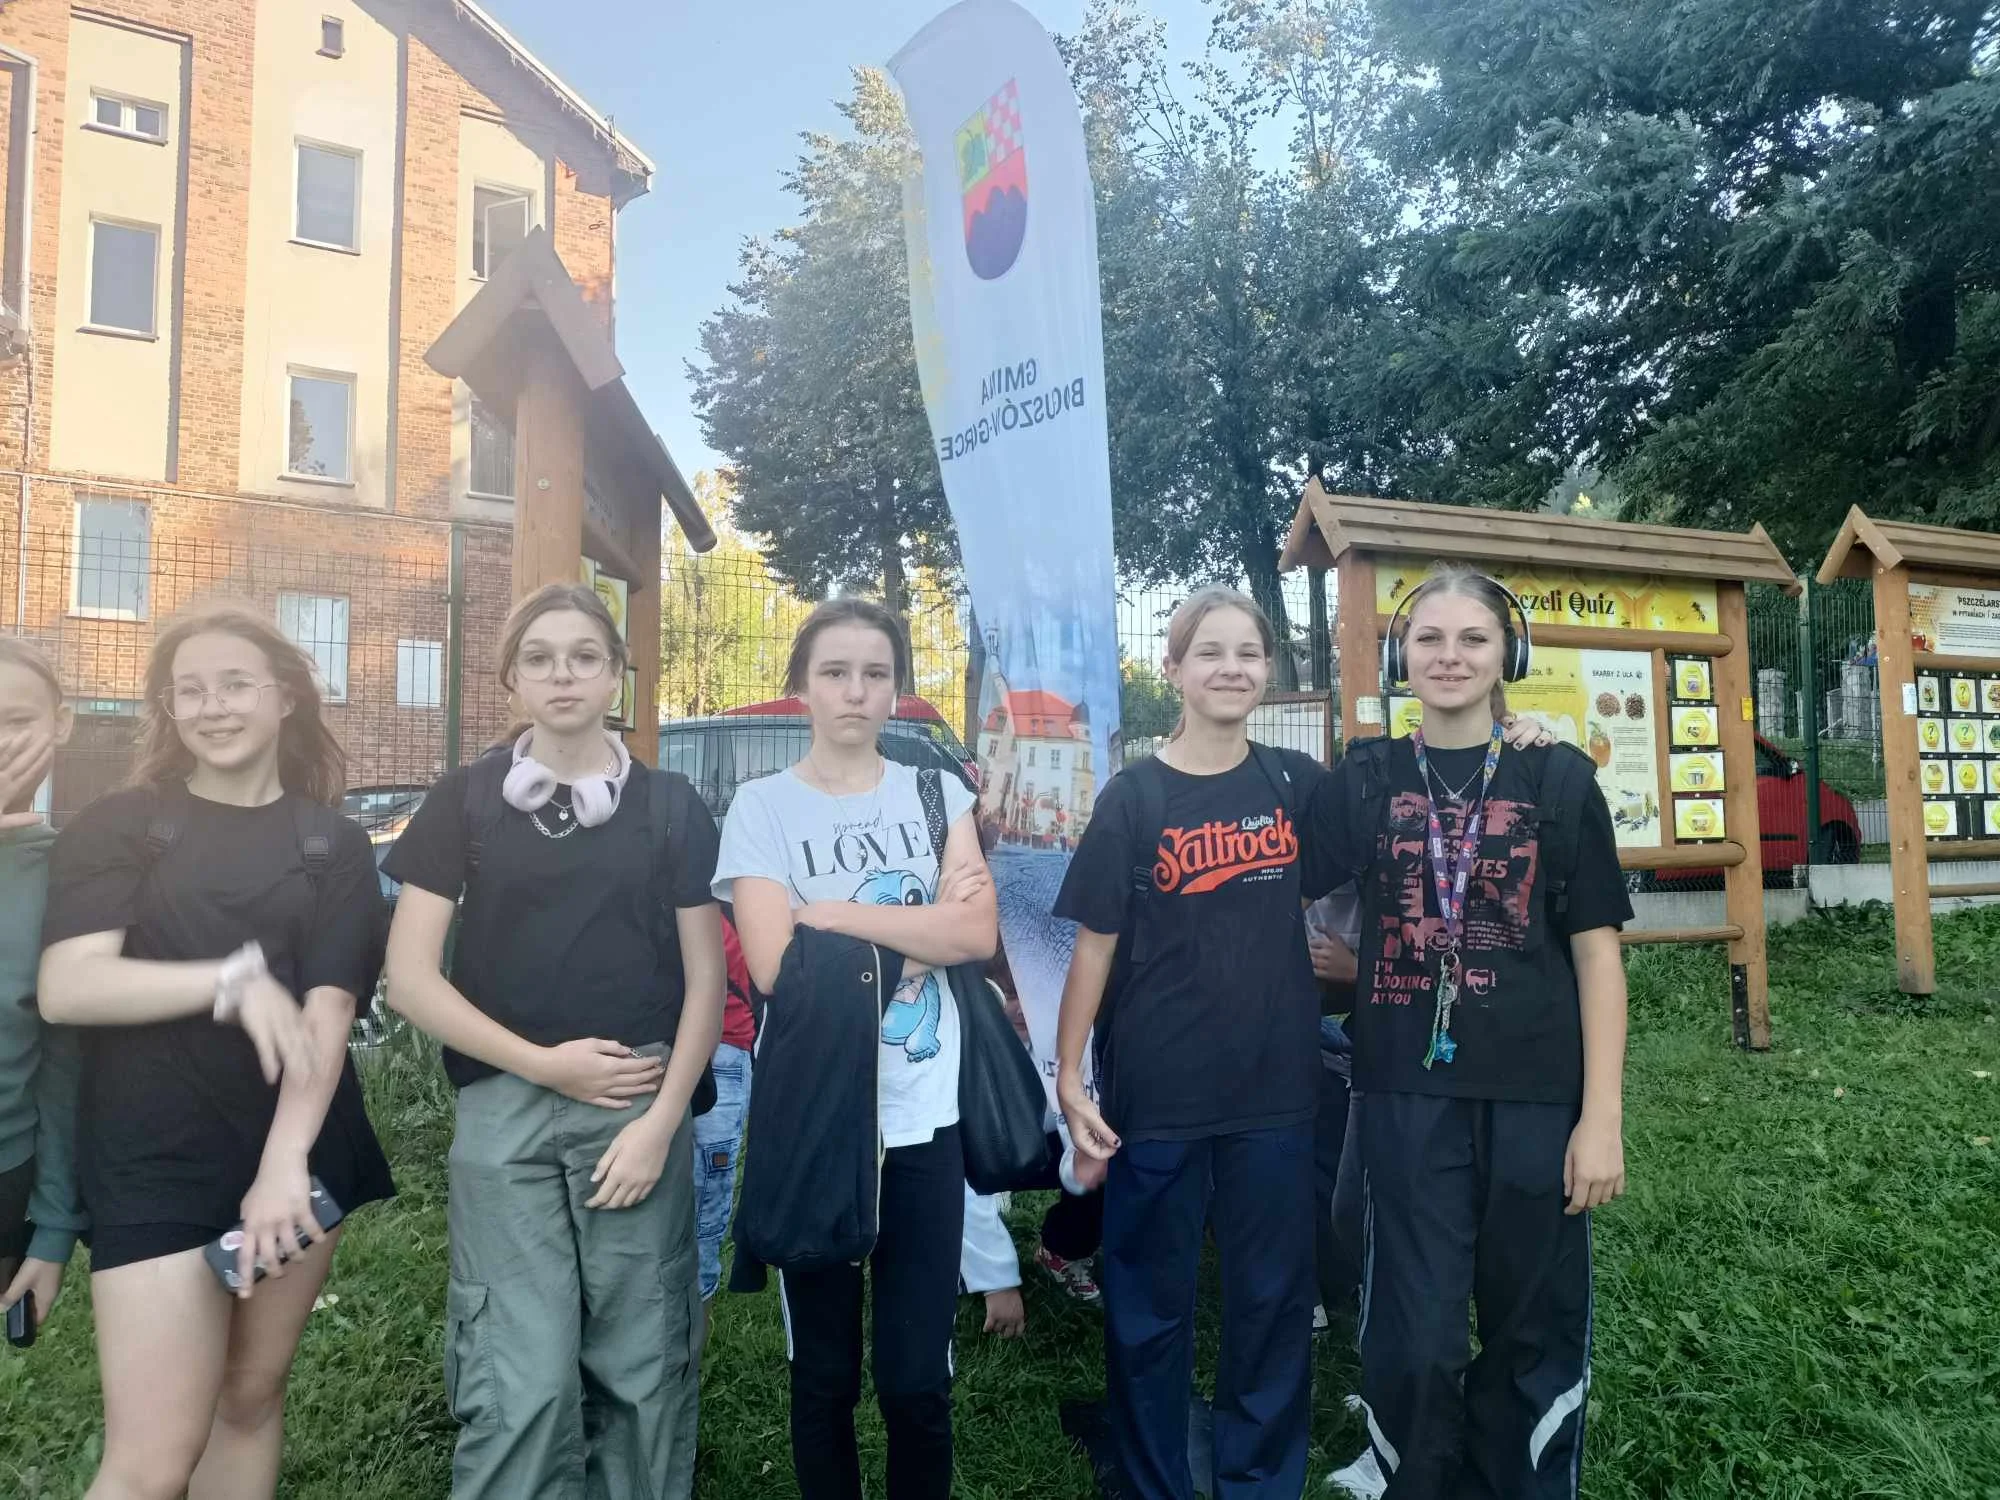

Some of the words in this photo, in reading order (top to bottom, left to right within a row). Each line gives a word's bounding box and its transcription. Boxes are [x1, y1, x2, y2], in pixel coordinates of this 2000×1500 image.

[1568, 591, 1616, 618] Quiz
[797, 820, 932, 880] LOVE
[1152, 808, 1298, 894] Saltrock
[1374, 973, 1432, 991] LOOKING
[1370, 992, 1386, 1005] AT
[1388, 992, 1411, 1006] YOU
